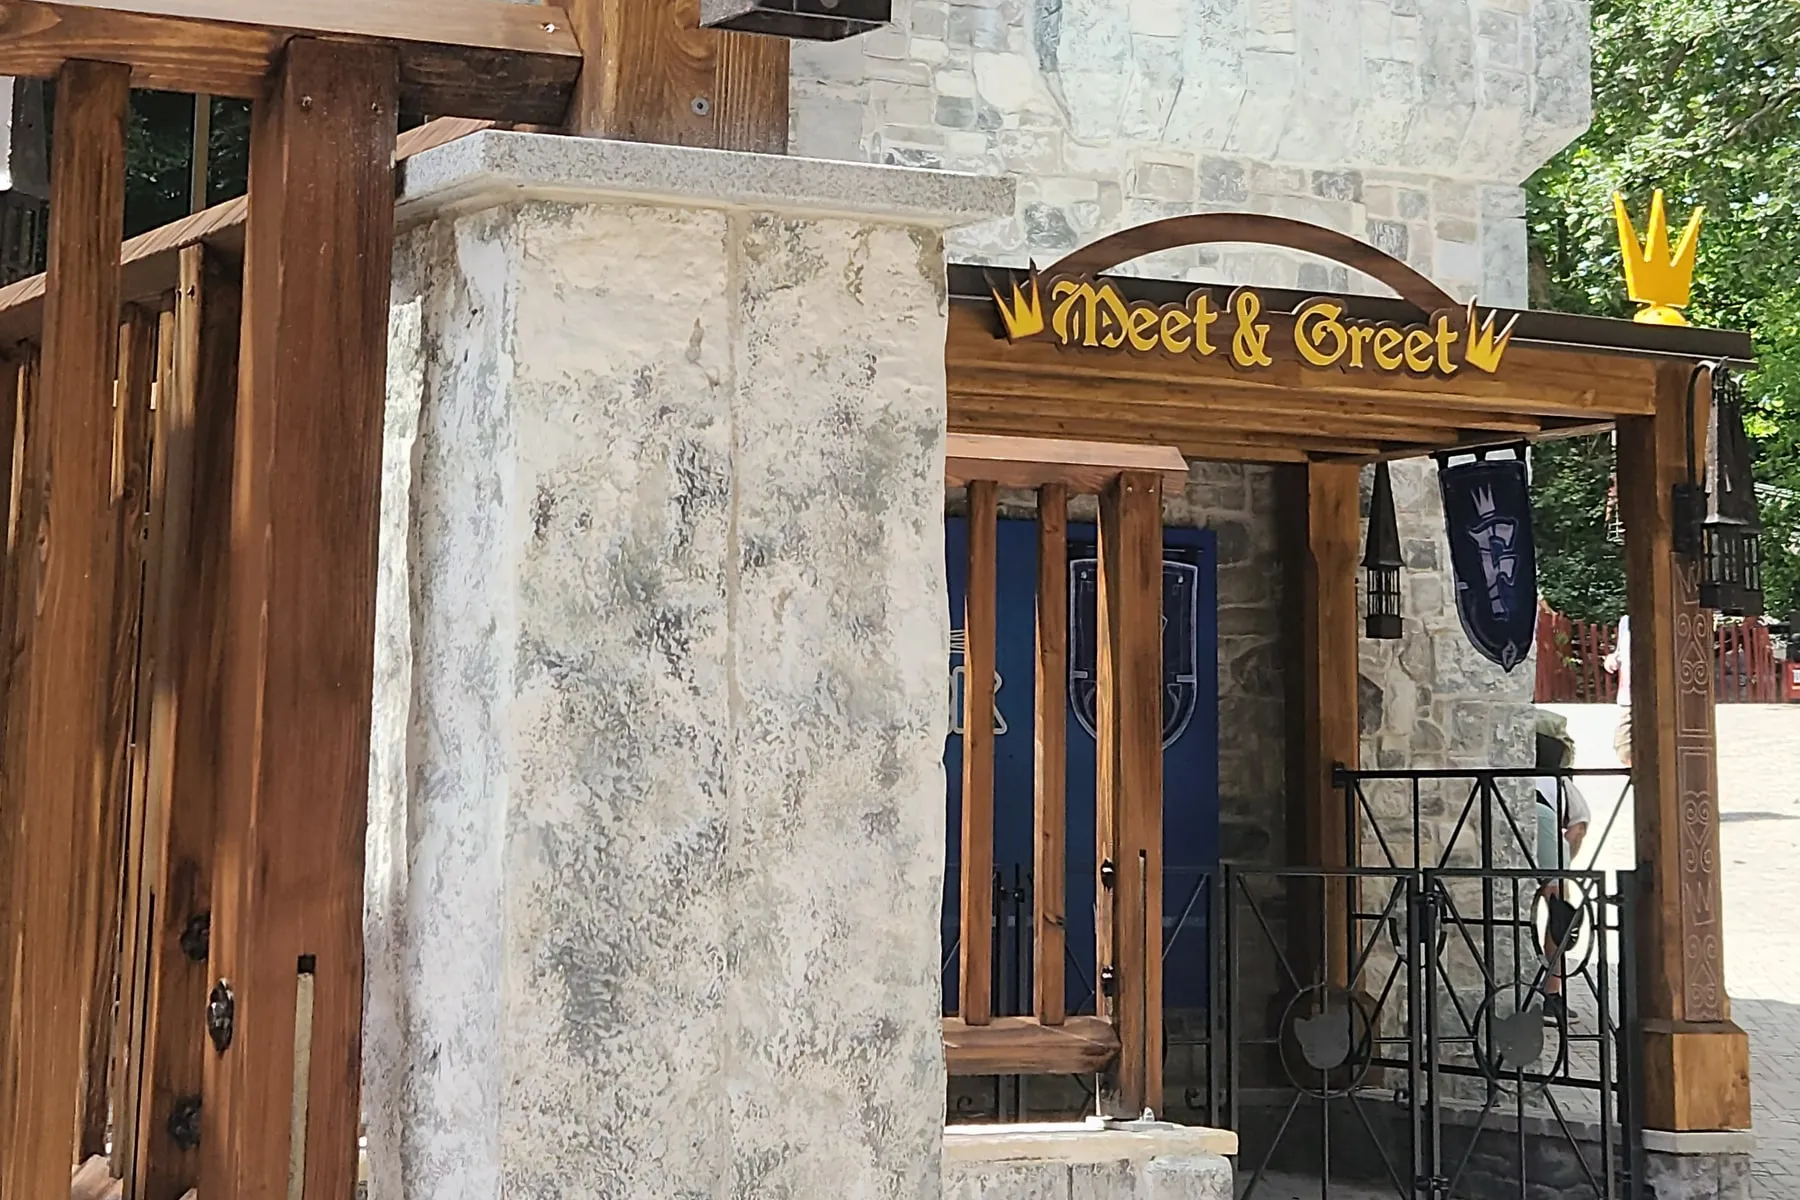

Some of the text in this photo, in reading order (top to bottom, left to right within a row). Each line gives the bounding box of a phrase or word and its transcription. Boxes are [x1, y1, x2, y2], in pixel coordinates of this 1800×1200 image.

[1052, 280, 1459, 374] Meet & Greet
